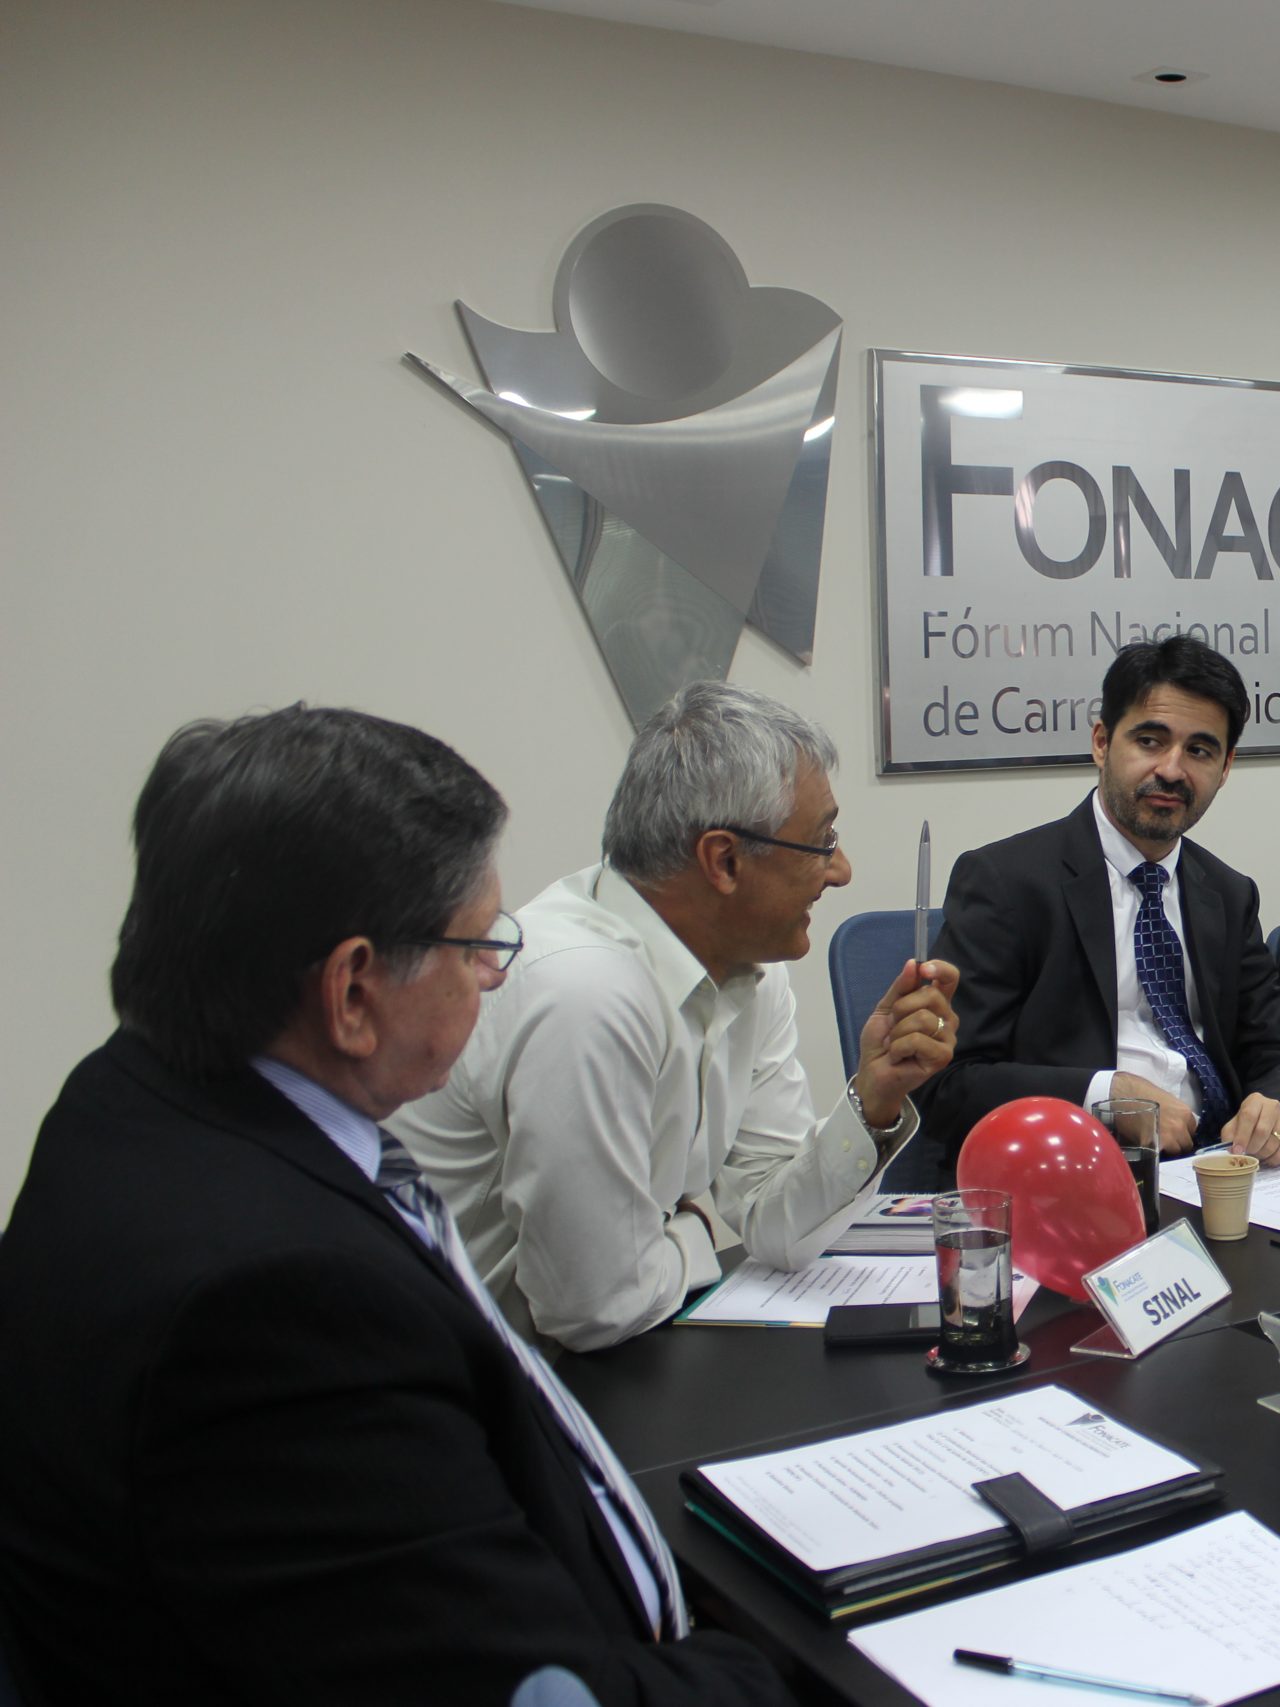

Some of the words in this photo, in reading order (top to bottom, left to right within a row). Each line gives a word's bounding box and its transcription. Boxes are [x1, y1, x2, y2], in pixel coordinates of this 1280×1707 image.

[923, 607, 1074, 659] Fórum
[1091, 608, 1270, 656] Nacional
[923, 685, 979, 737] de
[1113, 1272, 1143, 1291] FONACATE
[1142, 1278, 1202, 1326] SINAL
